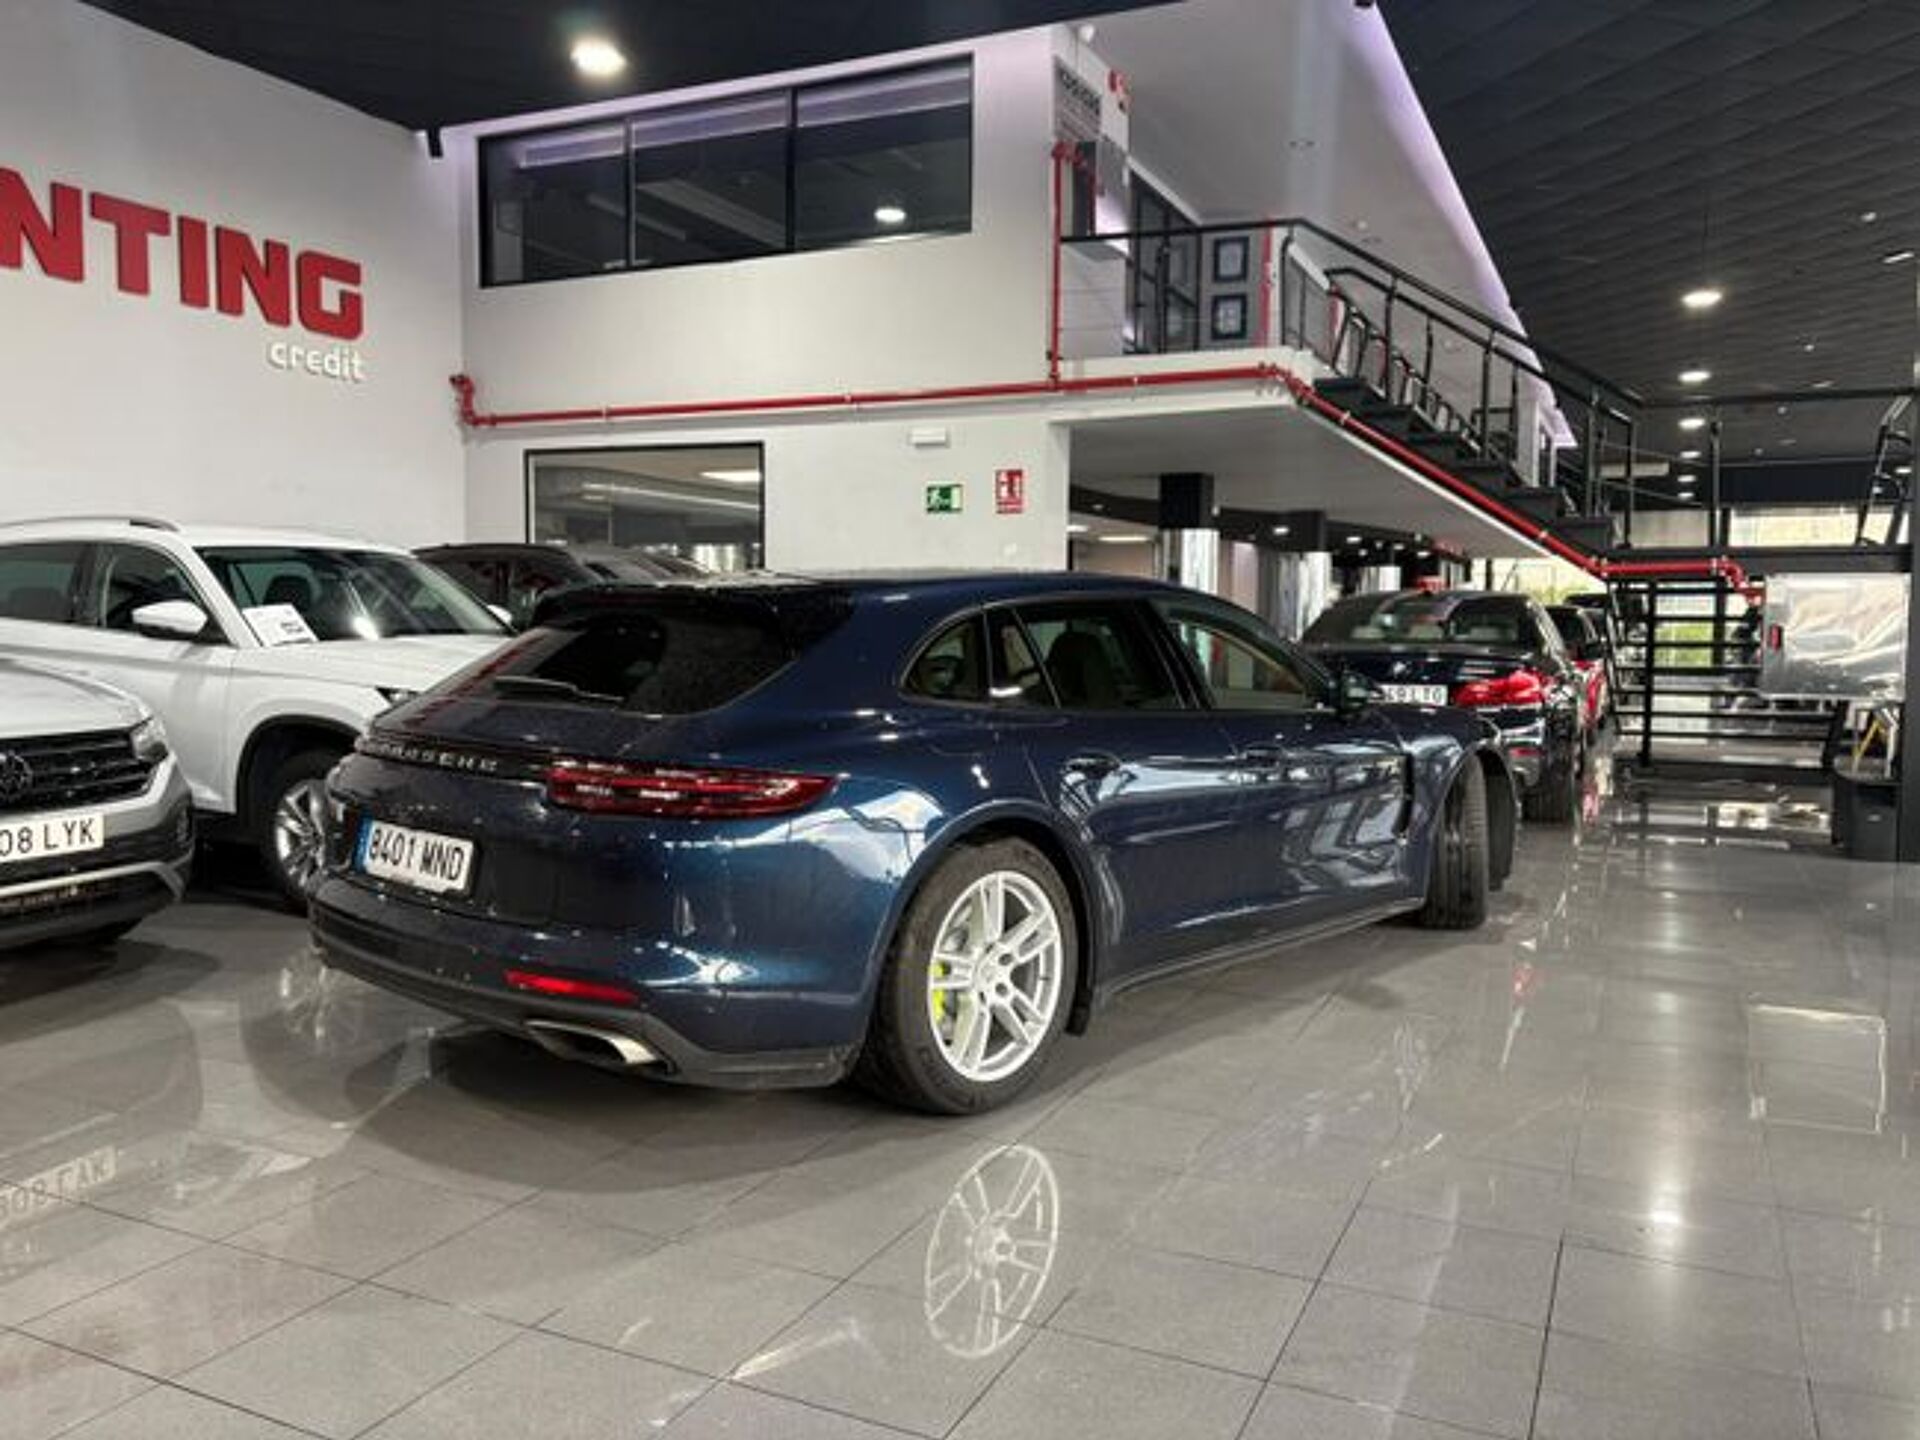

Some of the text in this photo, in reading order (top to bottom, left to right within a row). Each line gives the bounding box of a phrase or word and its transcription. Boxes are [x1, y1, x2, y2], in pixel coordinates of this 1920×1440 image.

[0, 167, 363, 340] NTING
[270, 341, 364, 379] credit
[44, 818, 95, 849] LYK
[369, 828, 465, 880] 8401 MND
